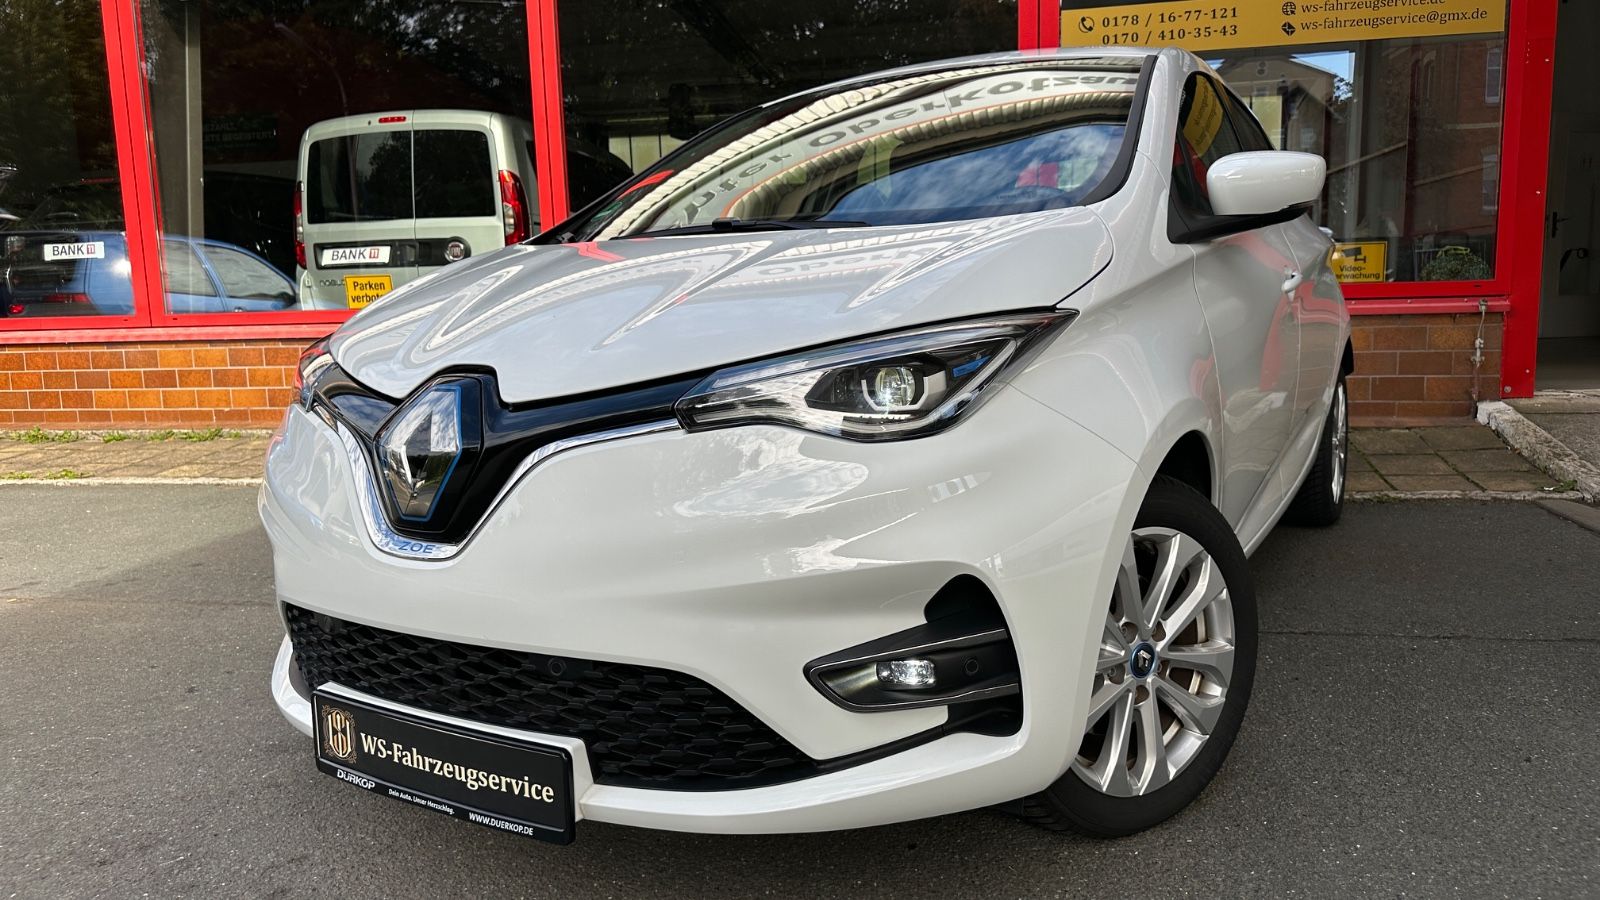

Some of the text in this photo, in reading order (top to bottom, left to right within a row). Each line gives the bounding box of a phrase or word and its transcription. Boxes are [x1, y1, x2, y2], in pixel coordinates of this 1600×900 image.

[1301, 0, 1446, 13] ws-fahrzeugservice.de
[1102, 7, 1238, 28] 0178 / 16-77-121
[1300, 8, 1488, 31] ws-fahrzeugservice@gmx.de
[1102, 24, 1238, 45] 0170 / 410-35-43
[52, 244, 84, 256] BANK
[331, 248, 366, 261] BANK
[353, 281, 386, 291] Parken
[351, 292, 383, 303] verbot
[399, 541, 435, 554] ZOE
[360, 732, 555, 803] WS-Fahrzeugservice
[388, 788, 400, 797] Dein
[413, 795, 427, 805] Unser
[469, 812, 533, 836] WWW.DUERKOP.DE
